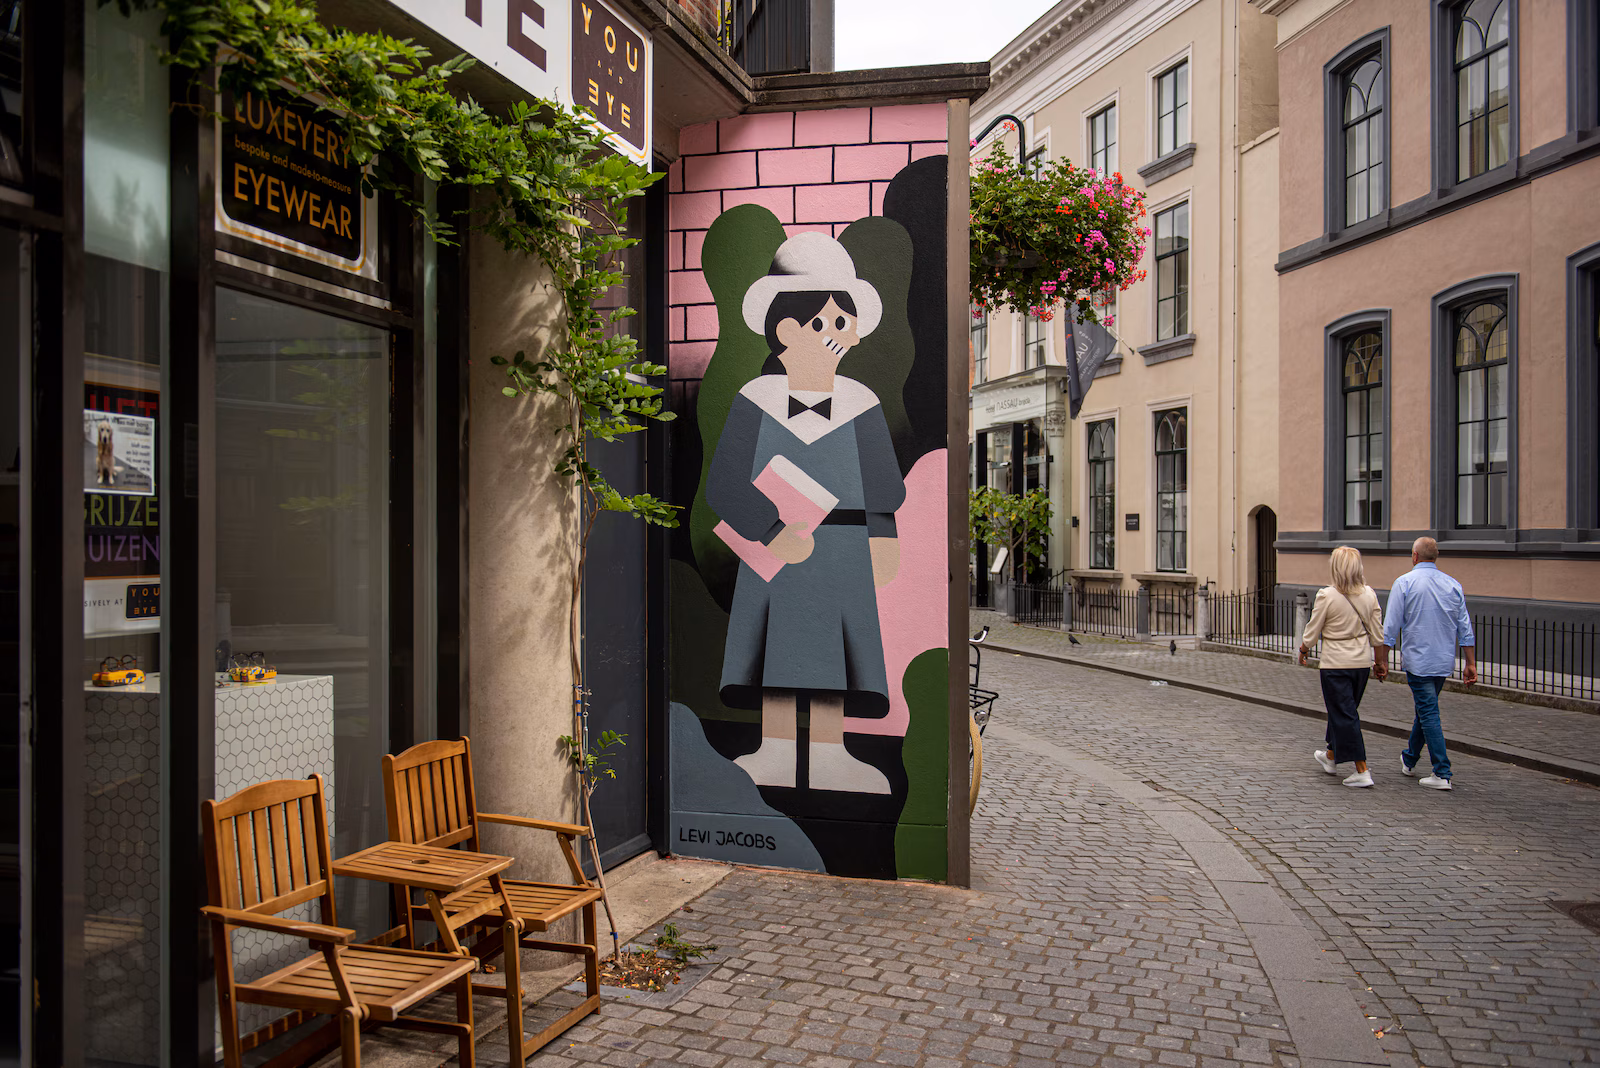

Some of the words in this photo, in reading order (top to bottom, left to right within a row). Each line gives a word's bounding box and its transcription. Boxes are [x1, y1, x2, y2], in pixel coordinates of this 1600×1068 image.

[581, 2, 638, 73] YOU
[234, 91, 352, 170] LUXEYERY
[234, 133, 270, 161] bespoke
[271, 154, 289, 169] and
[290, 160, 352, 196] made-to-measure
[233, 162, 353, 240] EYEWEAR
[84, 494, 159, 527] RIJZE
[84, 535, 160, 562] UIZEN
[131, 587, 160, 597] YOU
[679, 825, 710, 844] LEVI
[715, 830, 777, 851] JACOBS
